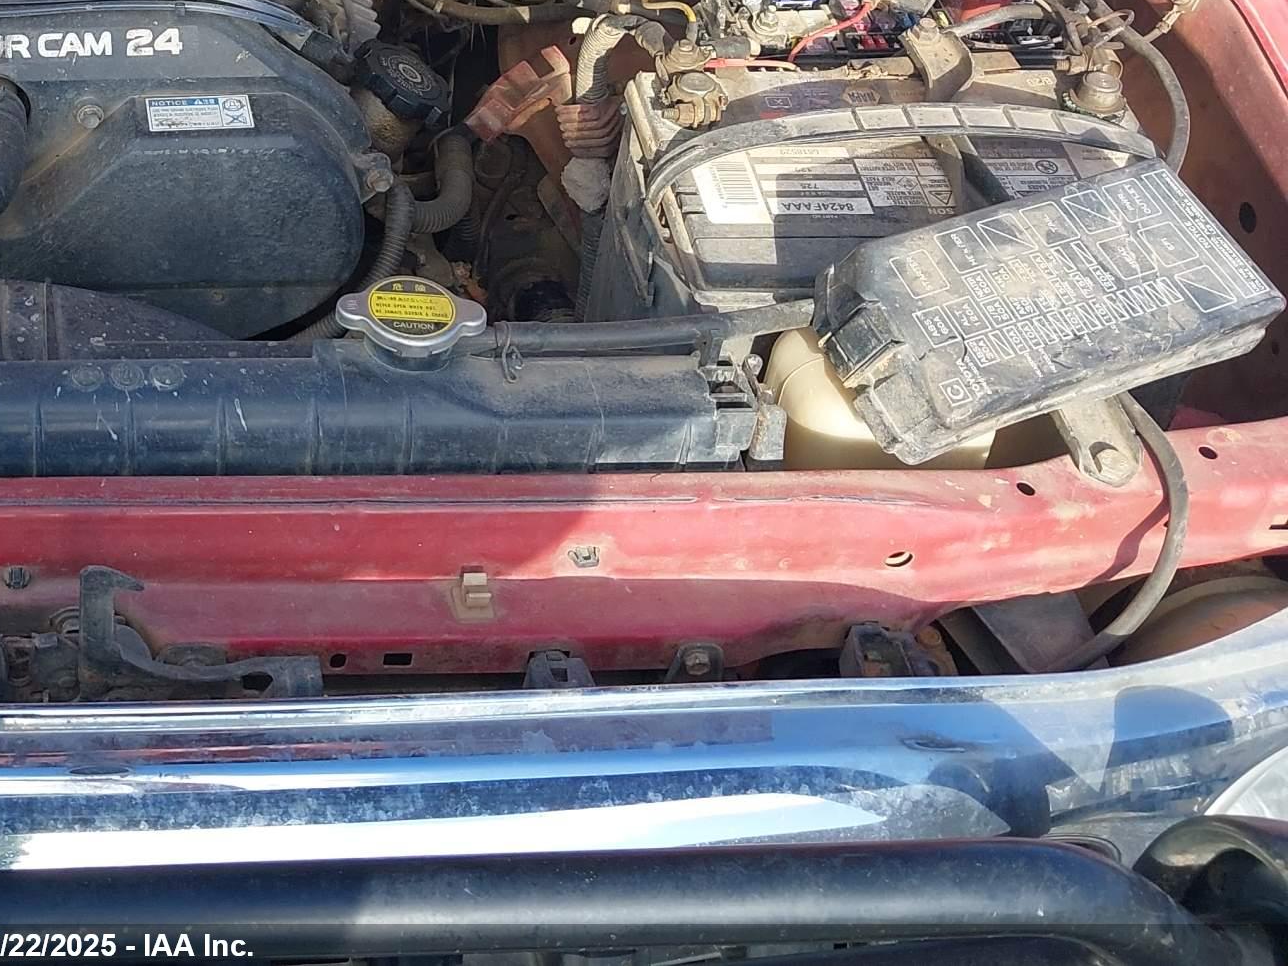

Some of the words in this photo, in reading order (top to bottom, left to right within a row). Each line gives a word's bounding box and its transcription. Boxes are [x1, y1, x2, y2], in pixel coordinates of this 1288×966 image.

[38, 32, 112, 58] CAM
[126, 28, 183, 57] 24
[781, 202, 854, 211] 8424FAAA
[1122, 182, 1153, 214] OUTLET
[1183, 220, 1211, 248] NOTICE
[394, 321, 434, 330] CAUTION
[953, 357, 984, 399] TOYOTA
